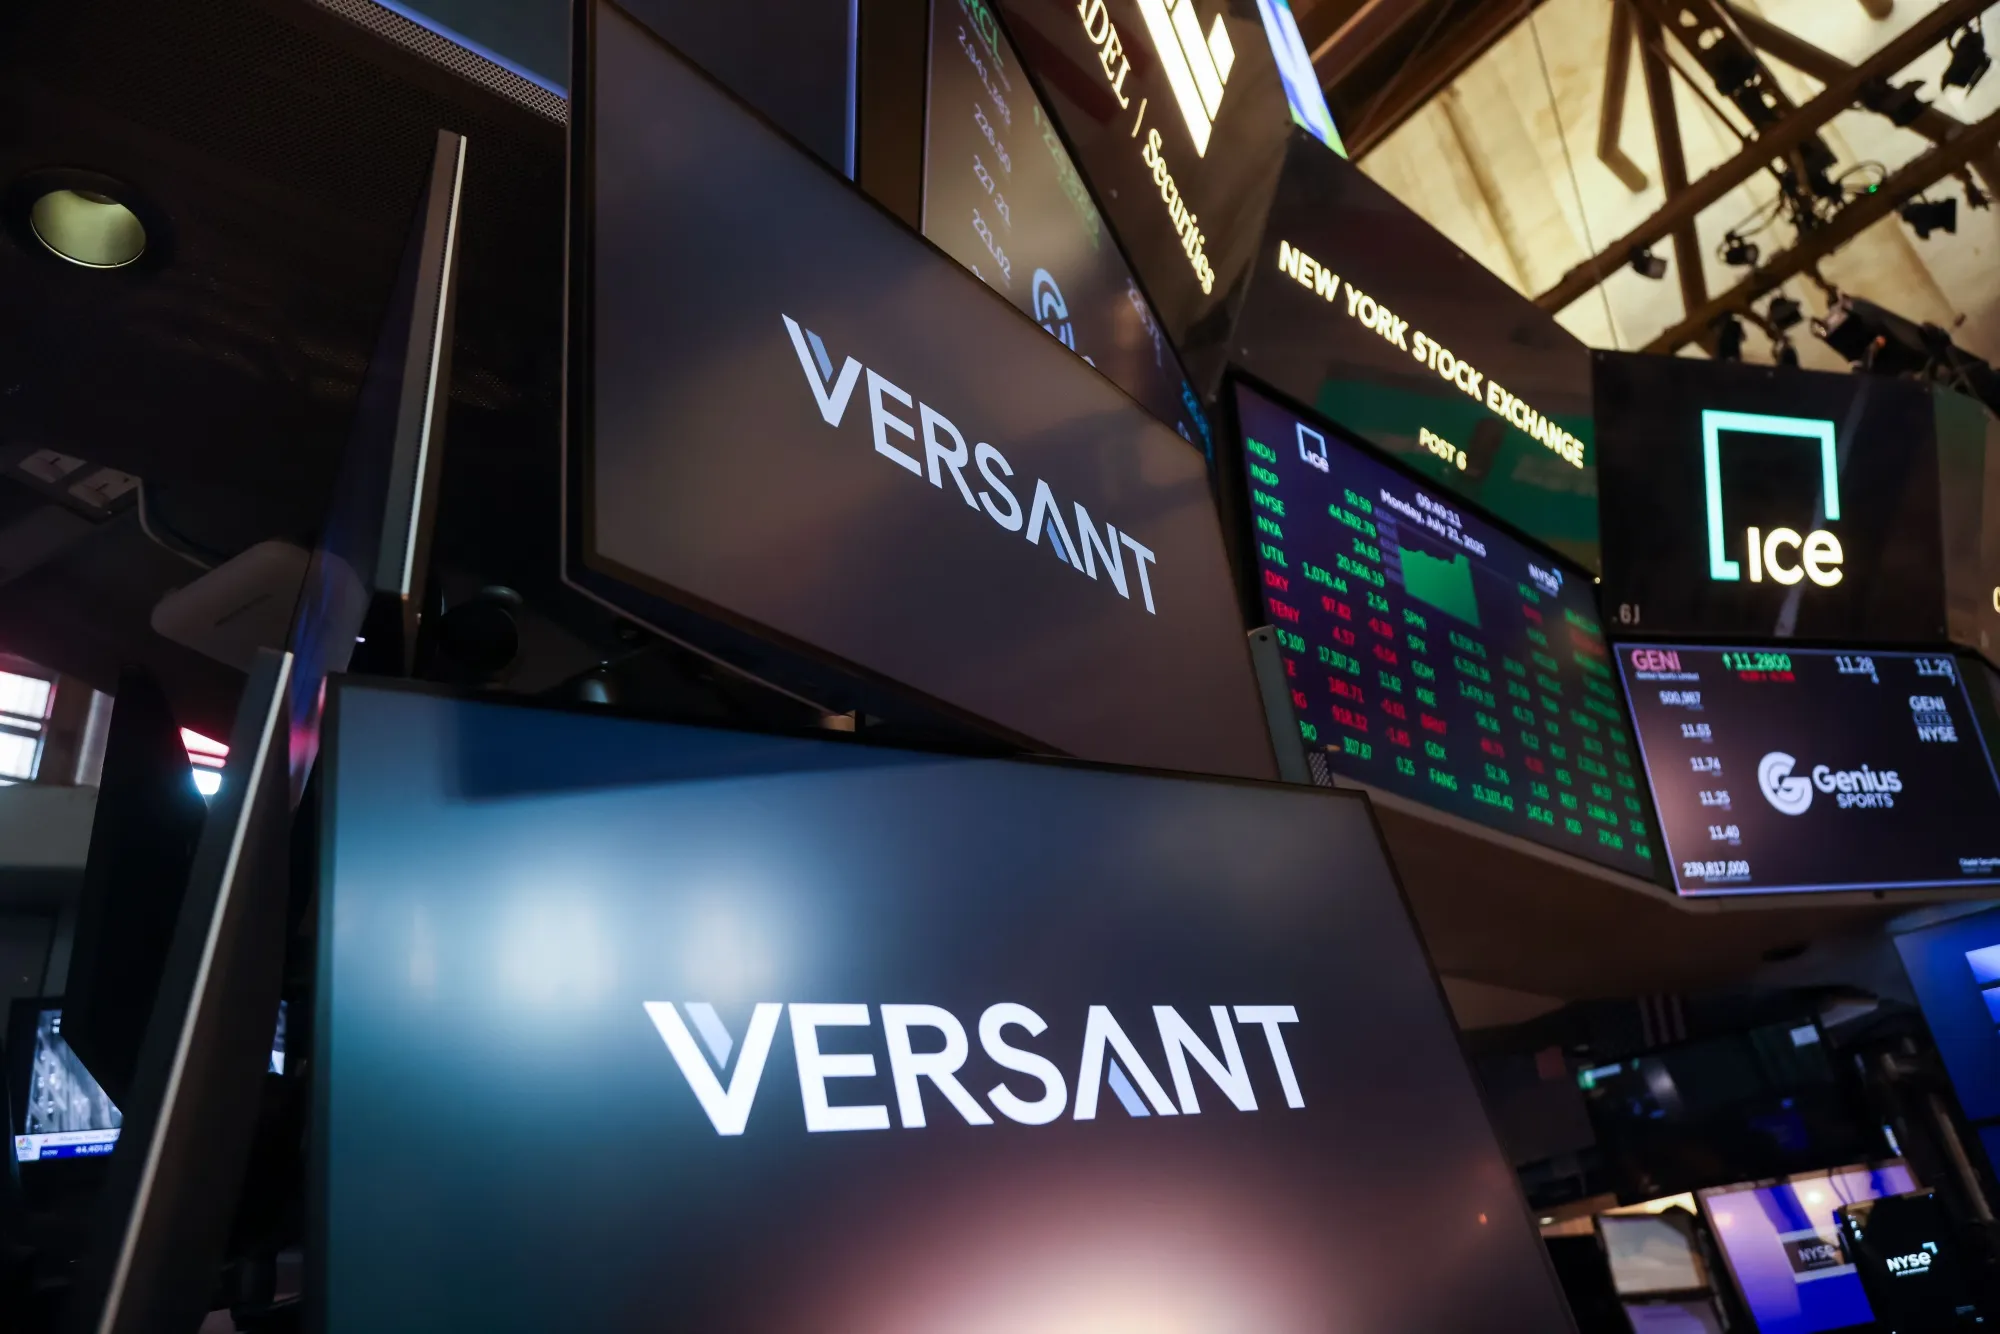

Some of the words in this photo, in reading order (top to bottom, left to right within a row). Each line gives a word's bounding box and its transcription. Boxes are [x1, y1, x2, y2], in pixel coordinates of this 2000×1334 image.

[1077, 0, 1131, 110] DEL
[1142, 129, 1215, 295] Securities
[1278, 240, 1340, 302] NEW
[1344, 282, 1409, 351] YORK
[1412, 331, 1483, 401] STOCK
[1487, 380, 1584, 469] EXCHANGE
[1247, 437, 1277, 464] INDU
[1419, 427, 1458, 464] POST
[1456, 451, 1467, 471] 6
[782, 313, 1156, 615] VERSANT
[1250, 463, 1279, 487] INDP
[1254, 490, 1284, 515] NYSE
[1258, 516, 1282, 538] NYA
[1381, 489, 1425, 524] Monday,
[1426, 515, 1445, 536] July
[1463, 535, 1486, 557] 2025
[1262, 543, 1288, 566] UTIL
[1303, 562, 1347, 593] 1,076.44
[1265, 570, 1288, 591] DXY
[1270, 598, 1299, 622] TENY
[1288, 633, 1305, 652] 100
[1631, 650, 1681, 672] GENI
[1733, 652, 1792, 671] 11.2800
[1835, 656, 1875, 674] 11.28
[1915, 658, 1953, 676] 11.29
[1909, 695, 1946, 712] GENI
[1917, 725, 1959, 742] NYSE
[1430, 768, 1457, 790] FANG
[1812, 764, 1902, 793] Genius
[1836, 793, 1894, 808] SPORTS
[643, 1001, 1305, 1136] VERSANT
